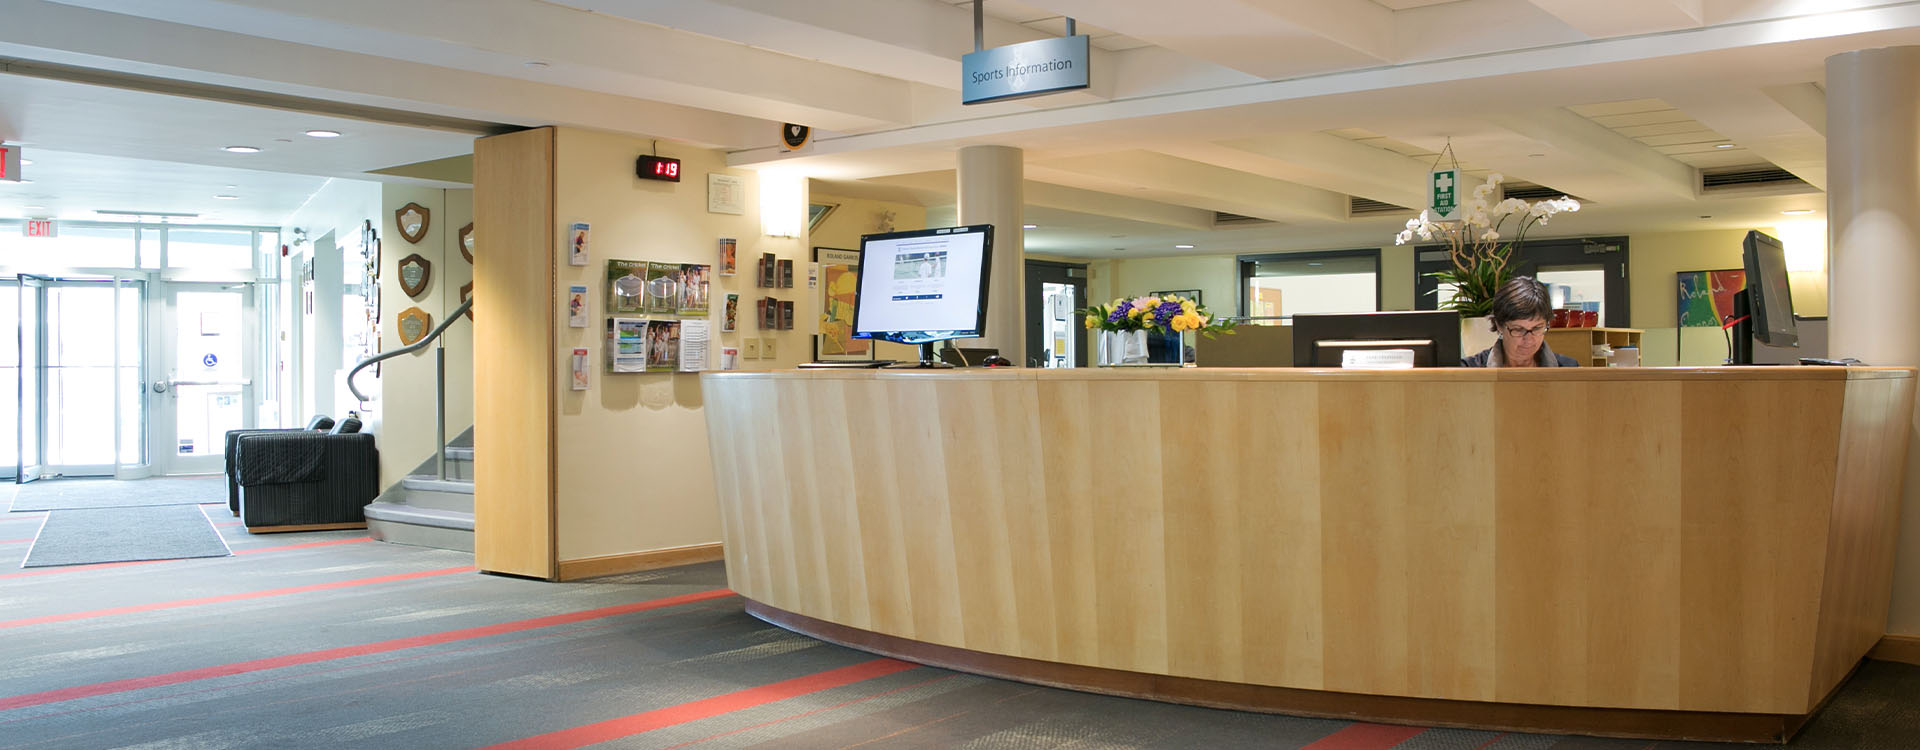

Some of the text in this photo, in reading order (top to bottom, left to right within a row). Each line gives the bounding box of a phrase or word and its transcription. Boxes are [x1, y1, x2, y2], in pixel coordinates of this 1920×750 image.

[972, 59, 1072, 85] Sports Information
[655, 161, 678, 178] 1:19
[28, 220, 51, 237] EXIT
